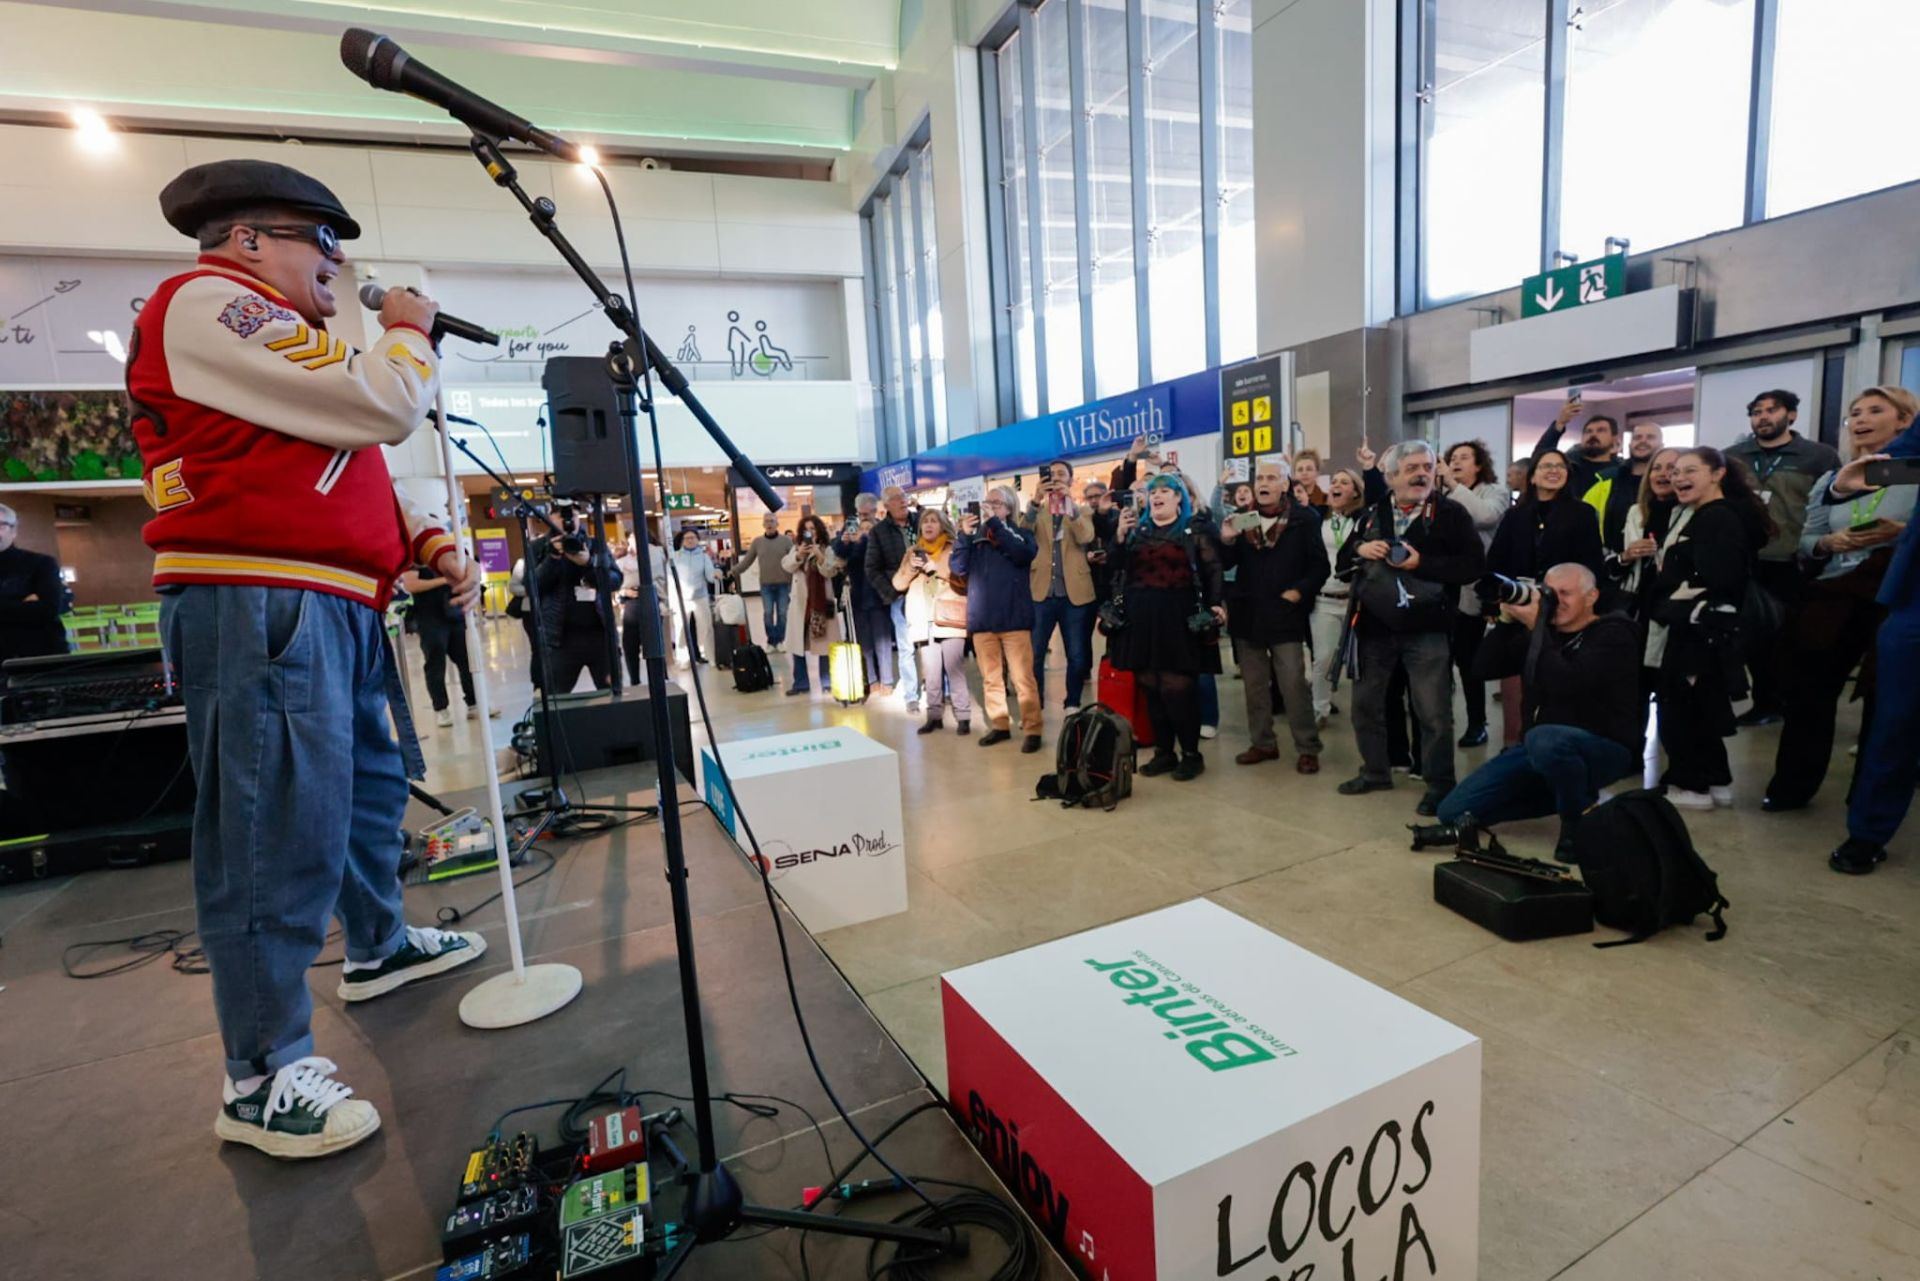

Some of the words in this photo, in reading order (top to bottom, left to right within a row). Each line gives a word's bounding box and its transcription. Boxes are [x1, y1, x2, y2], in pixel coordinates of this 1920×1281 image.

[11, 325, 35, 344] ti
[508, 339, 533, 358] for
[537, 342, 569, 359] you
[1058, 397, 1165, 449] WHSmith
[775, 843, 850, 870] SENA
[1181, 981, 1201, 994] de
[1083, 958, 1277, 1072] Binter
[969, 1089, 1069, 1252] enjoy
[1217, 1100, 1434, 1277] LOCOS
